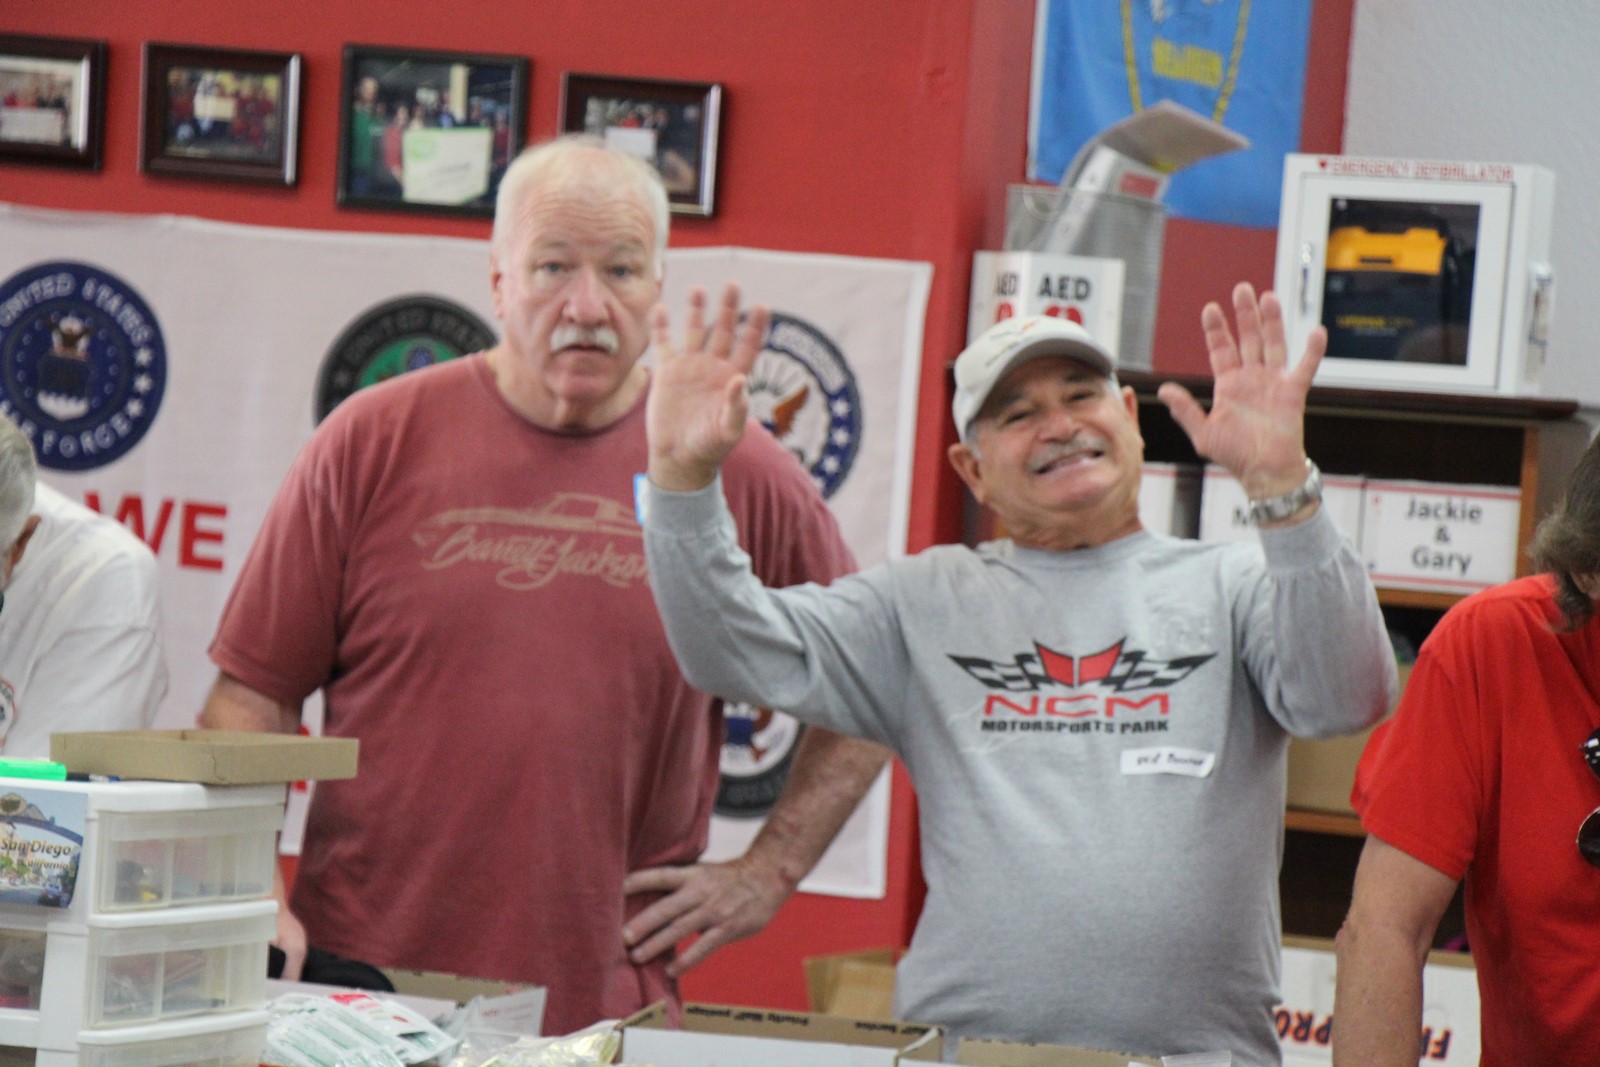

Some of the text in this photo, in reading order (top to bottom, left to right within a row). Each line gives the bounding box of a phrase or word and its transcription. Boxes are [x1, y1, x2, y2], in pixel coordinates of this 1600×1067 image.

[1332, 158, 1409, 177] EMERGENCY
[994, 273, 1018, 296] AED
[1039, 274, 1091, 300] AED
[82, 278, 153, 347] STATES
[42, 412, 132, 458] FORCE
[1407, 496, 1482, 523] Jackie
[84, 490, 228, 572] WE
[1436, 525, 1450, 543] &
[1412, 546, 1472, 576] Gary
[984, 694, 1169, 718] NCM
[981, 719, 1168, 734] MOTORSPORTS PARK
[1, 837, 72, 858] San Diego
